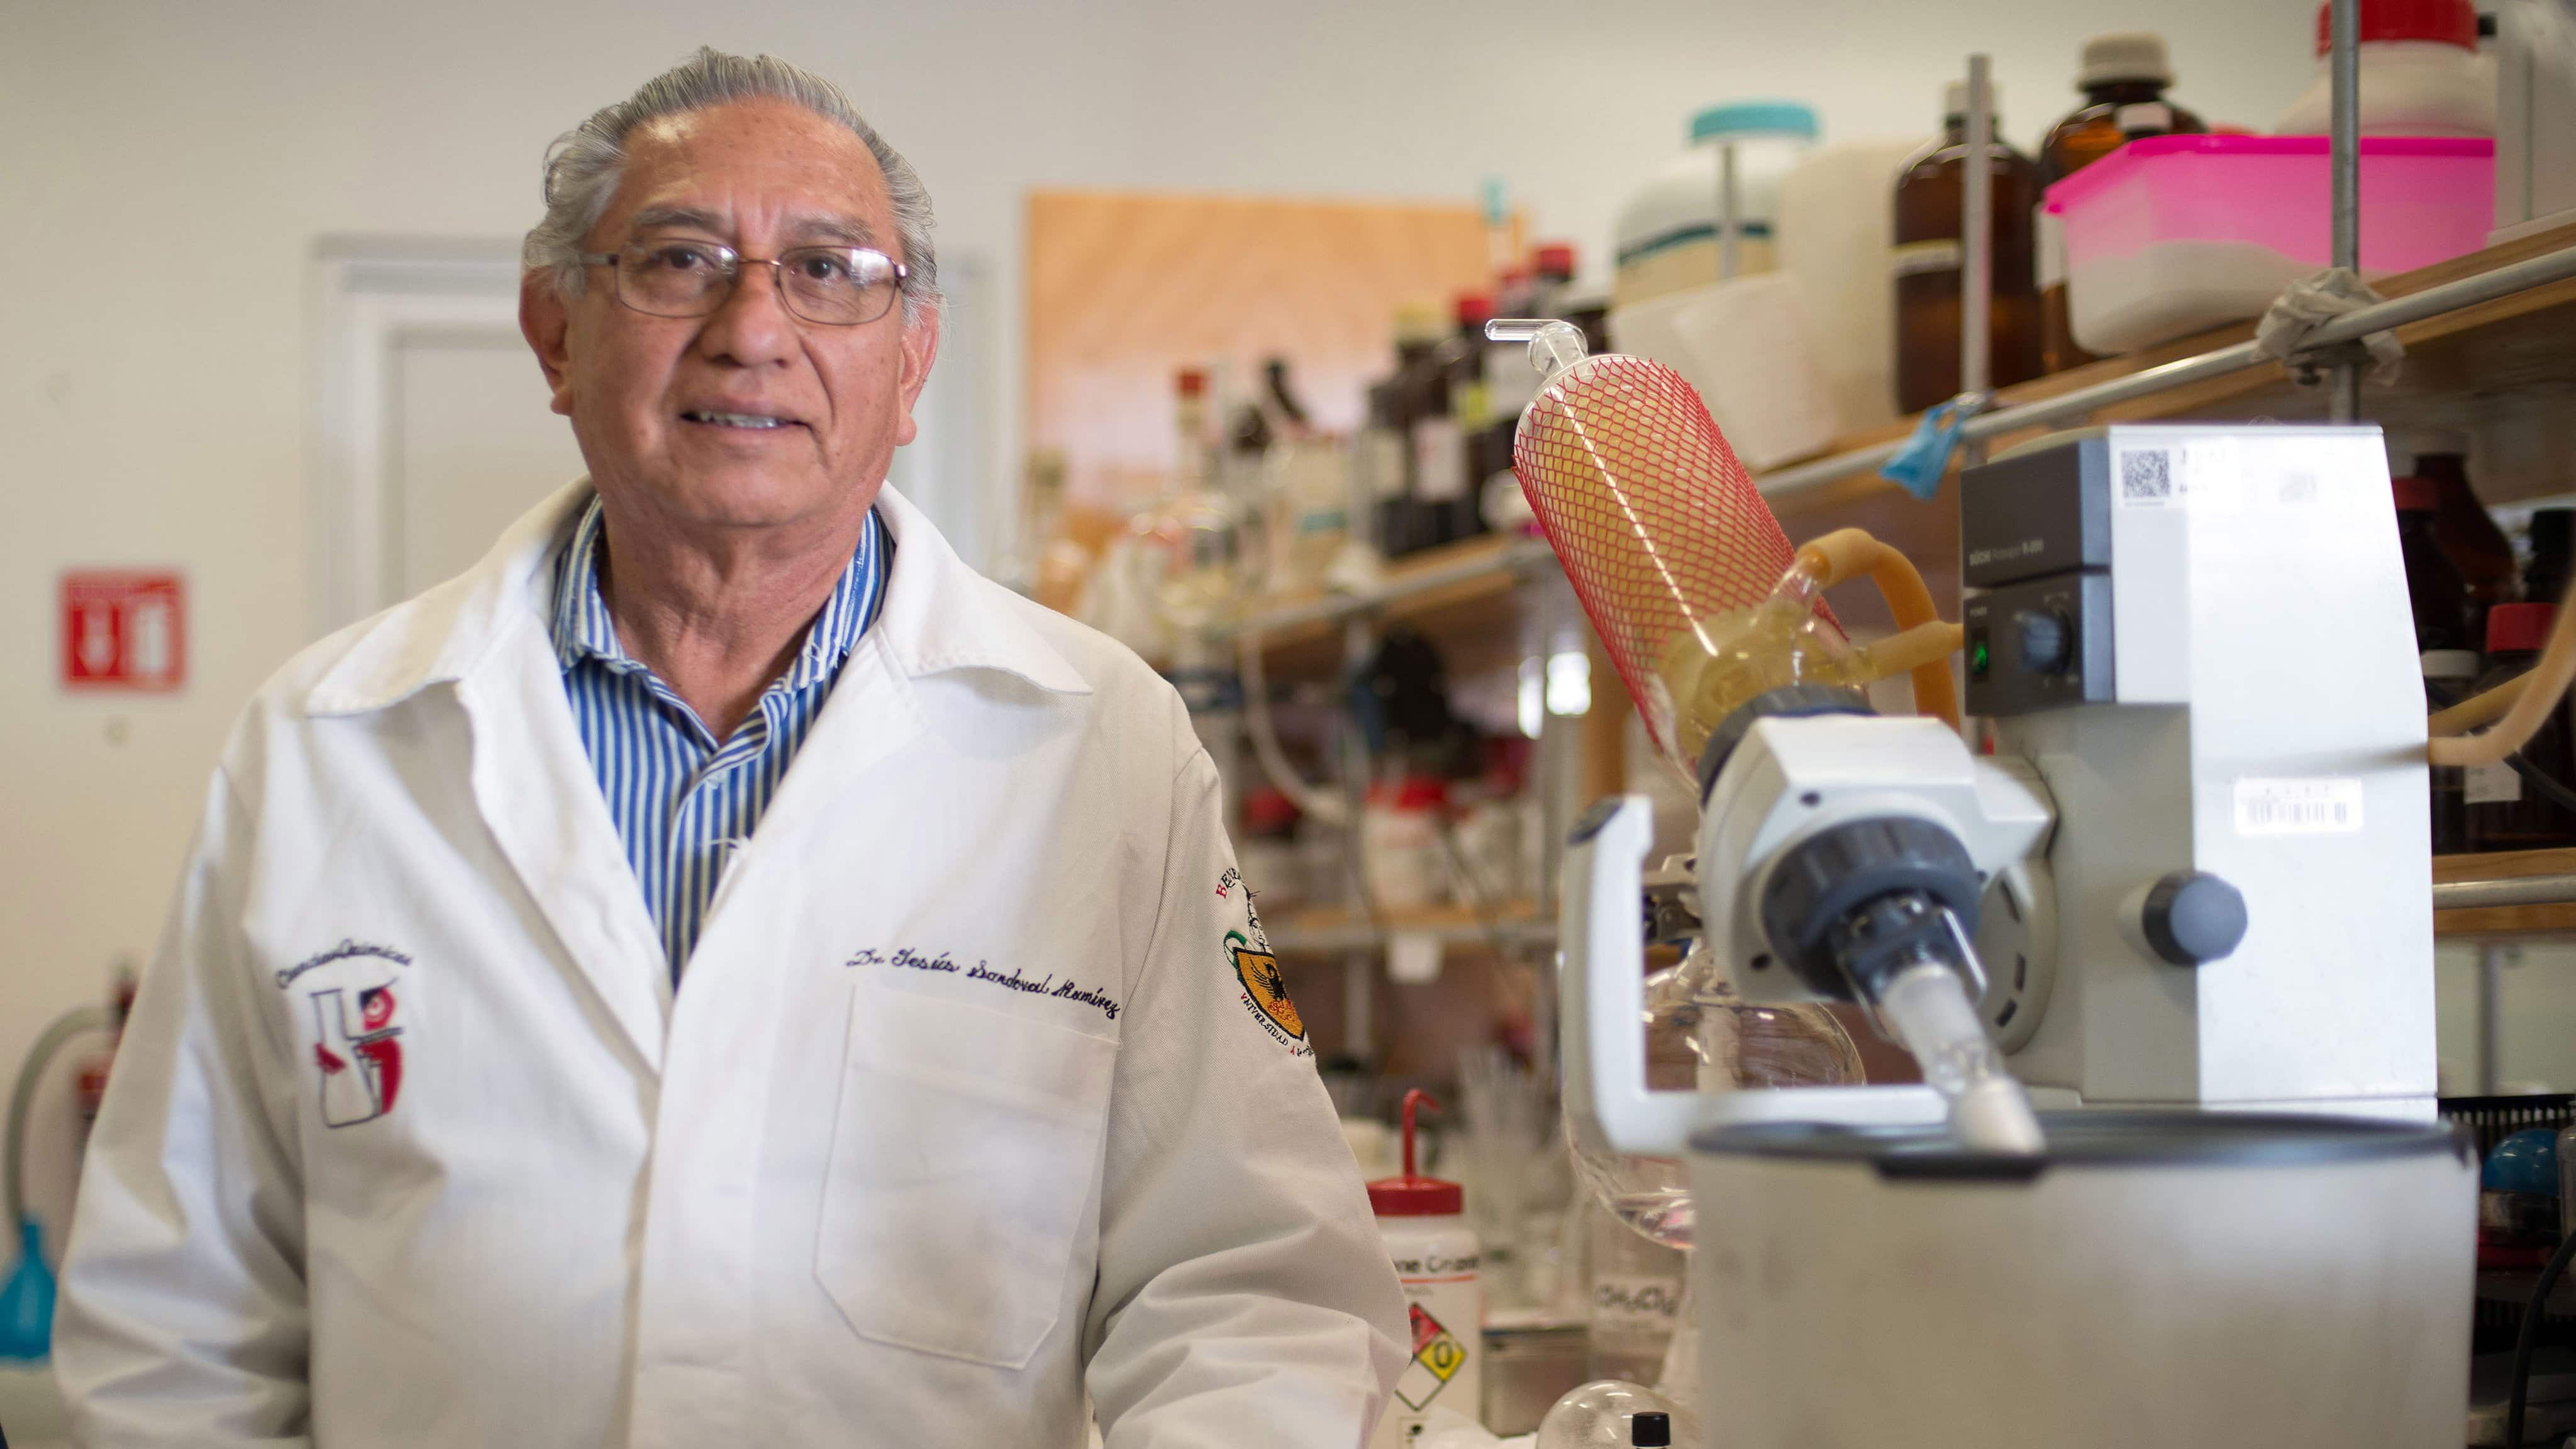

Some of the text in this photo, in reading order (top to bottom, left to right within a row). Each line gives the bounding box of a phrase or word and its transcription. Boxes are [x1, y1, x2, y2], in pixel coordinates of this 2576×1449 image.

[891, 948, 960, 972] Jesús
[967, 960, 1052, 994] Sandoval
[1051, 979, 1121, 1020] Ramírez
